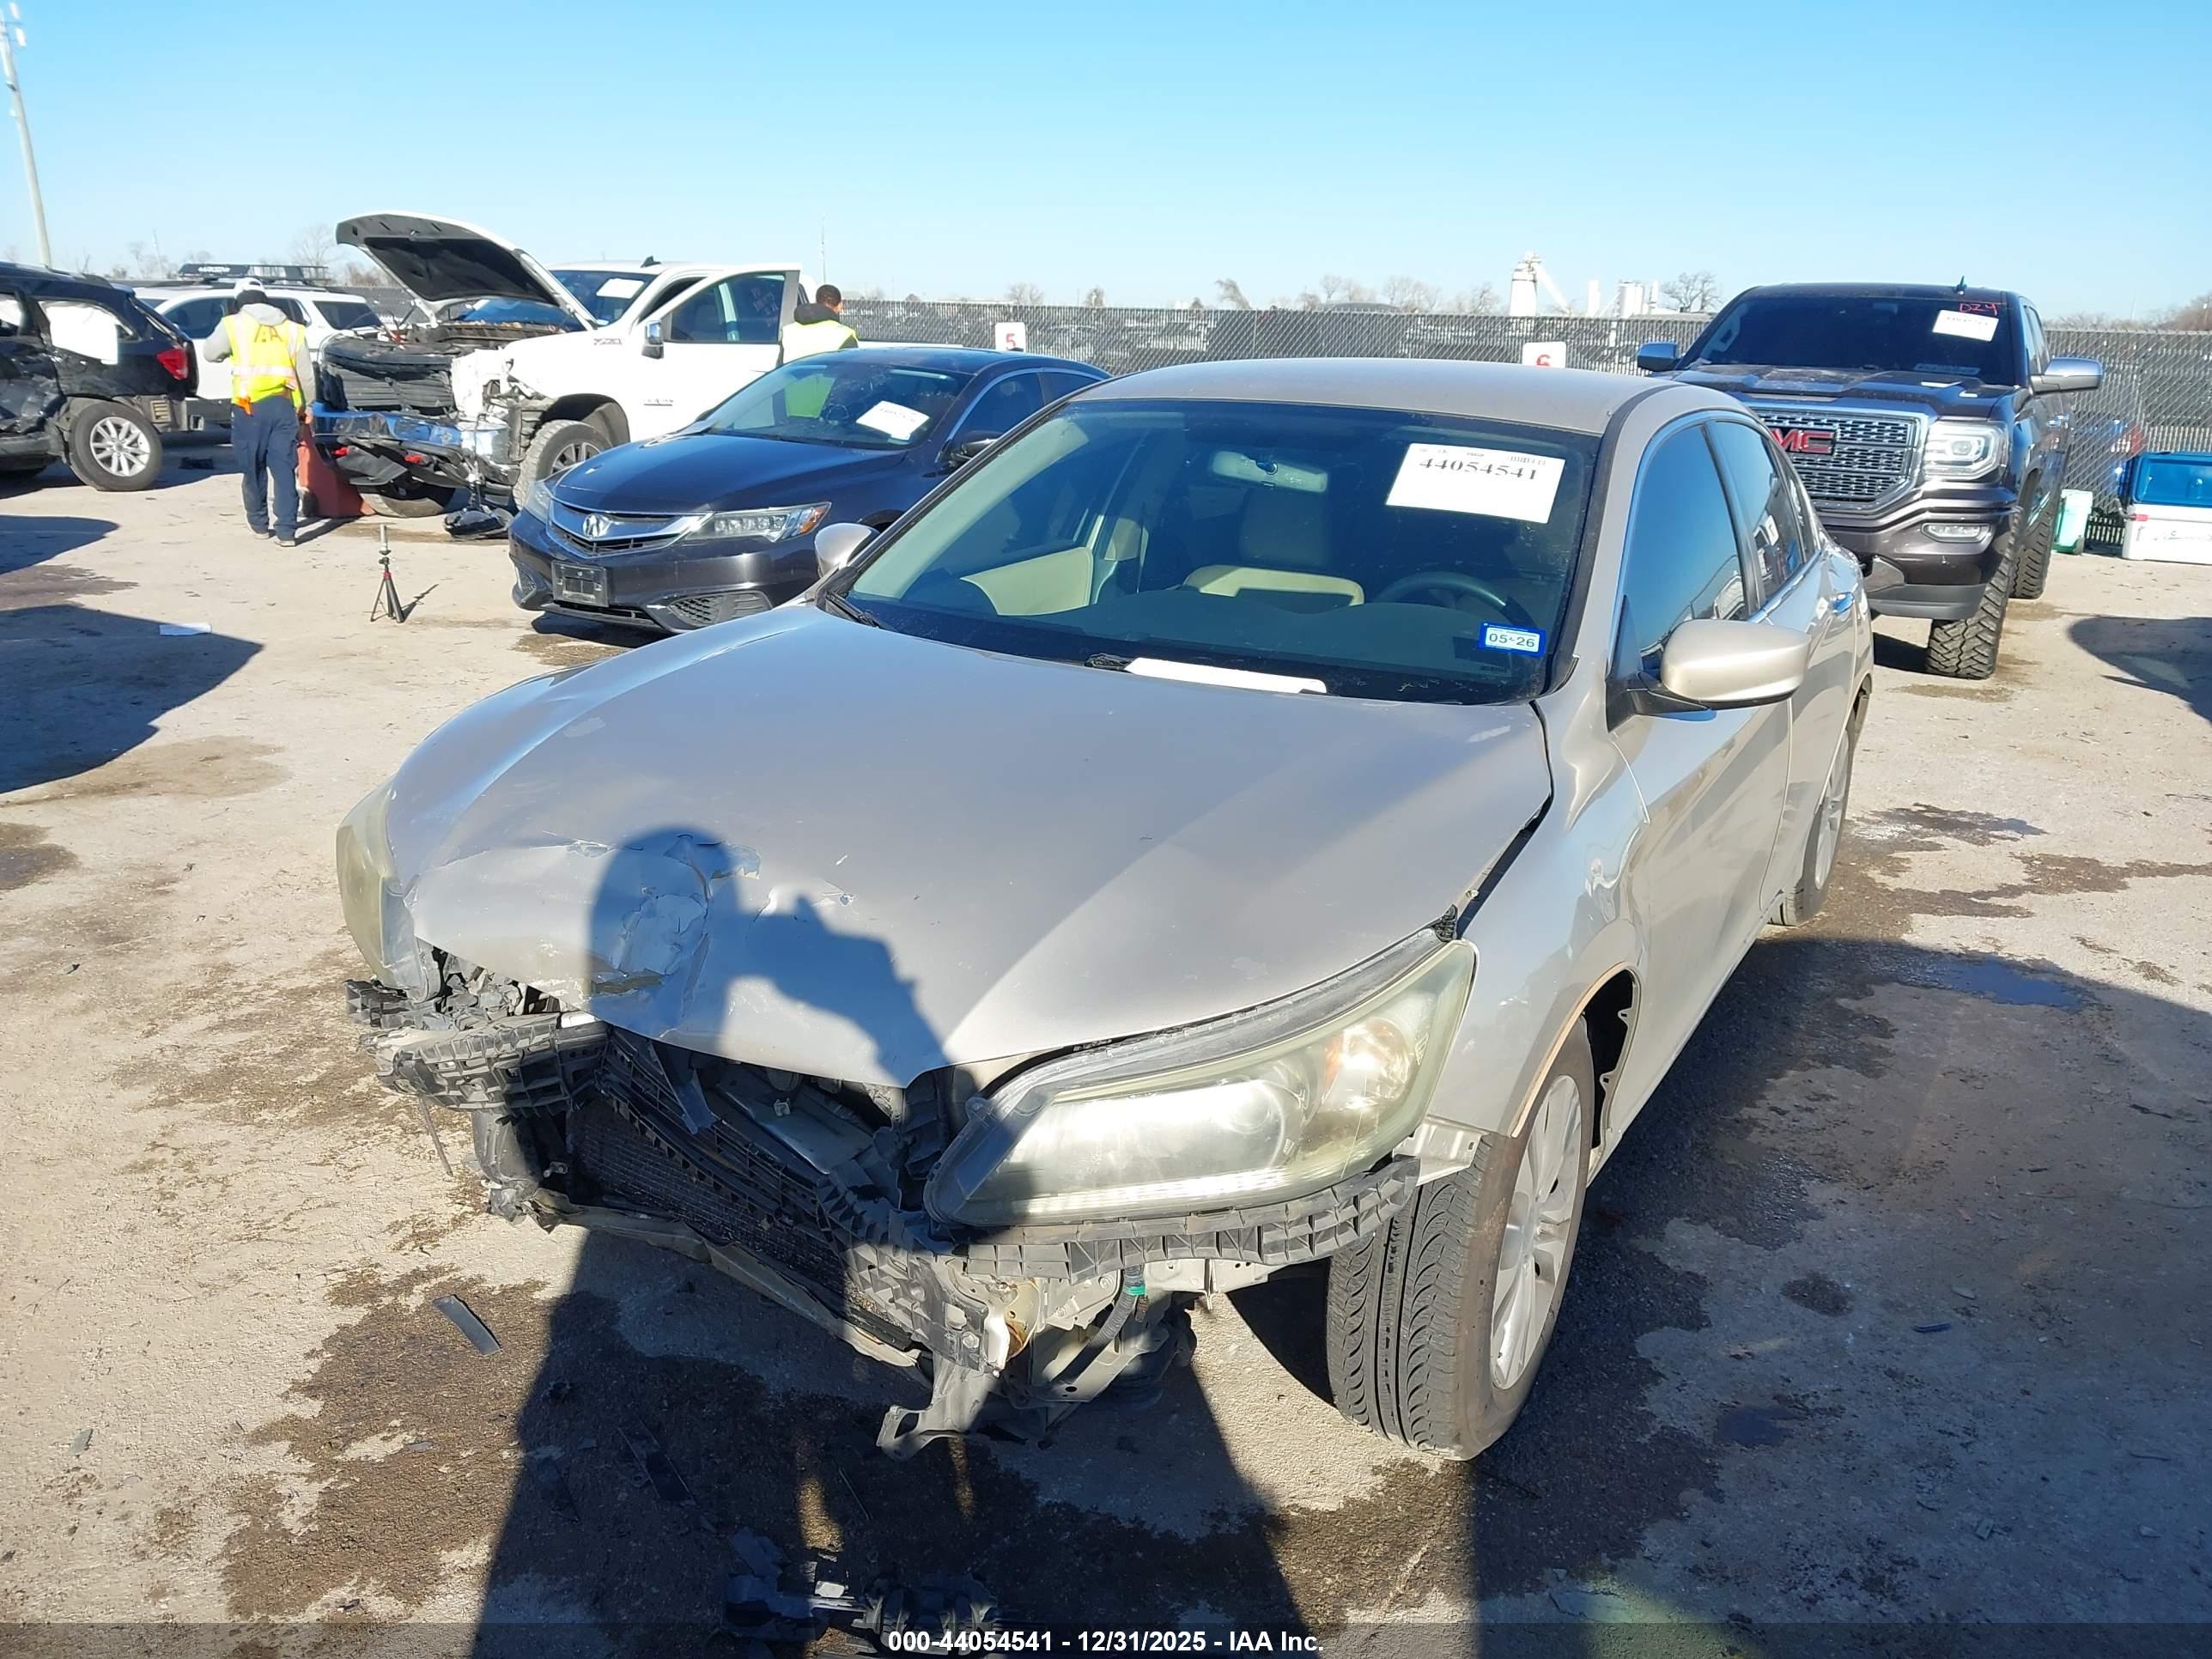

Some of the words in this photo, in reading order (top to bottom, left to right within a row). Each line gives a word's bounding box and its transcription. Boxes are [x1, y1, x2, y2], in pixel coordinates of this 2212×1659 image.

[1006, 332, 1017, 350] 5
[1771, 428, 1834, 453] MC
[1419, 458, 1537, 480] 44054541
